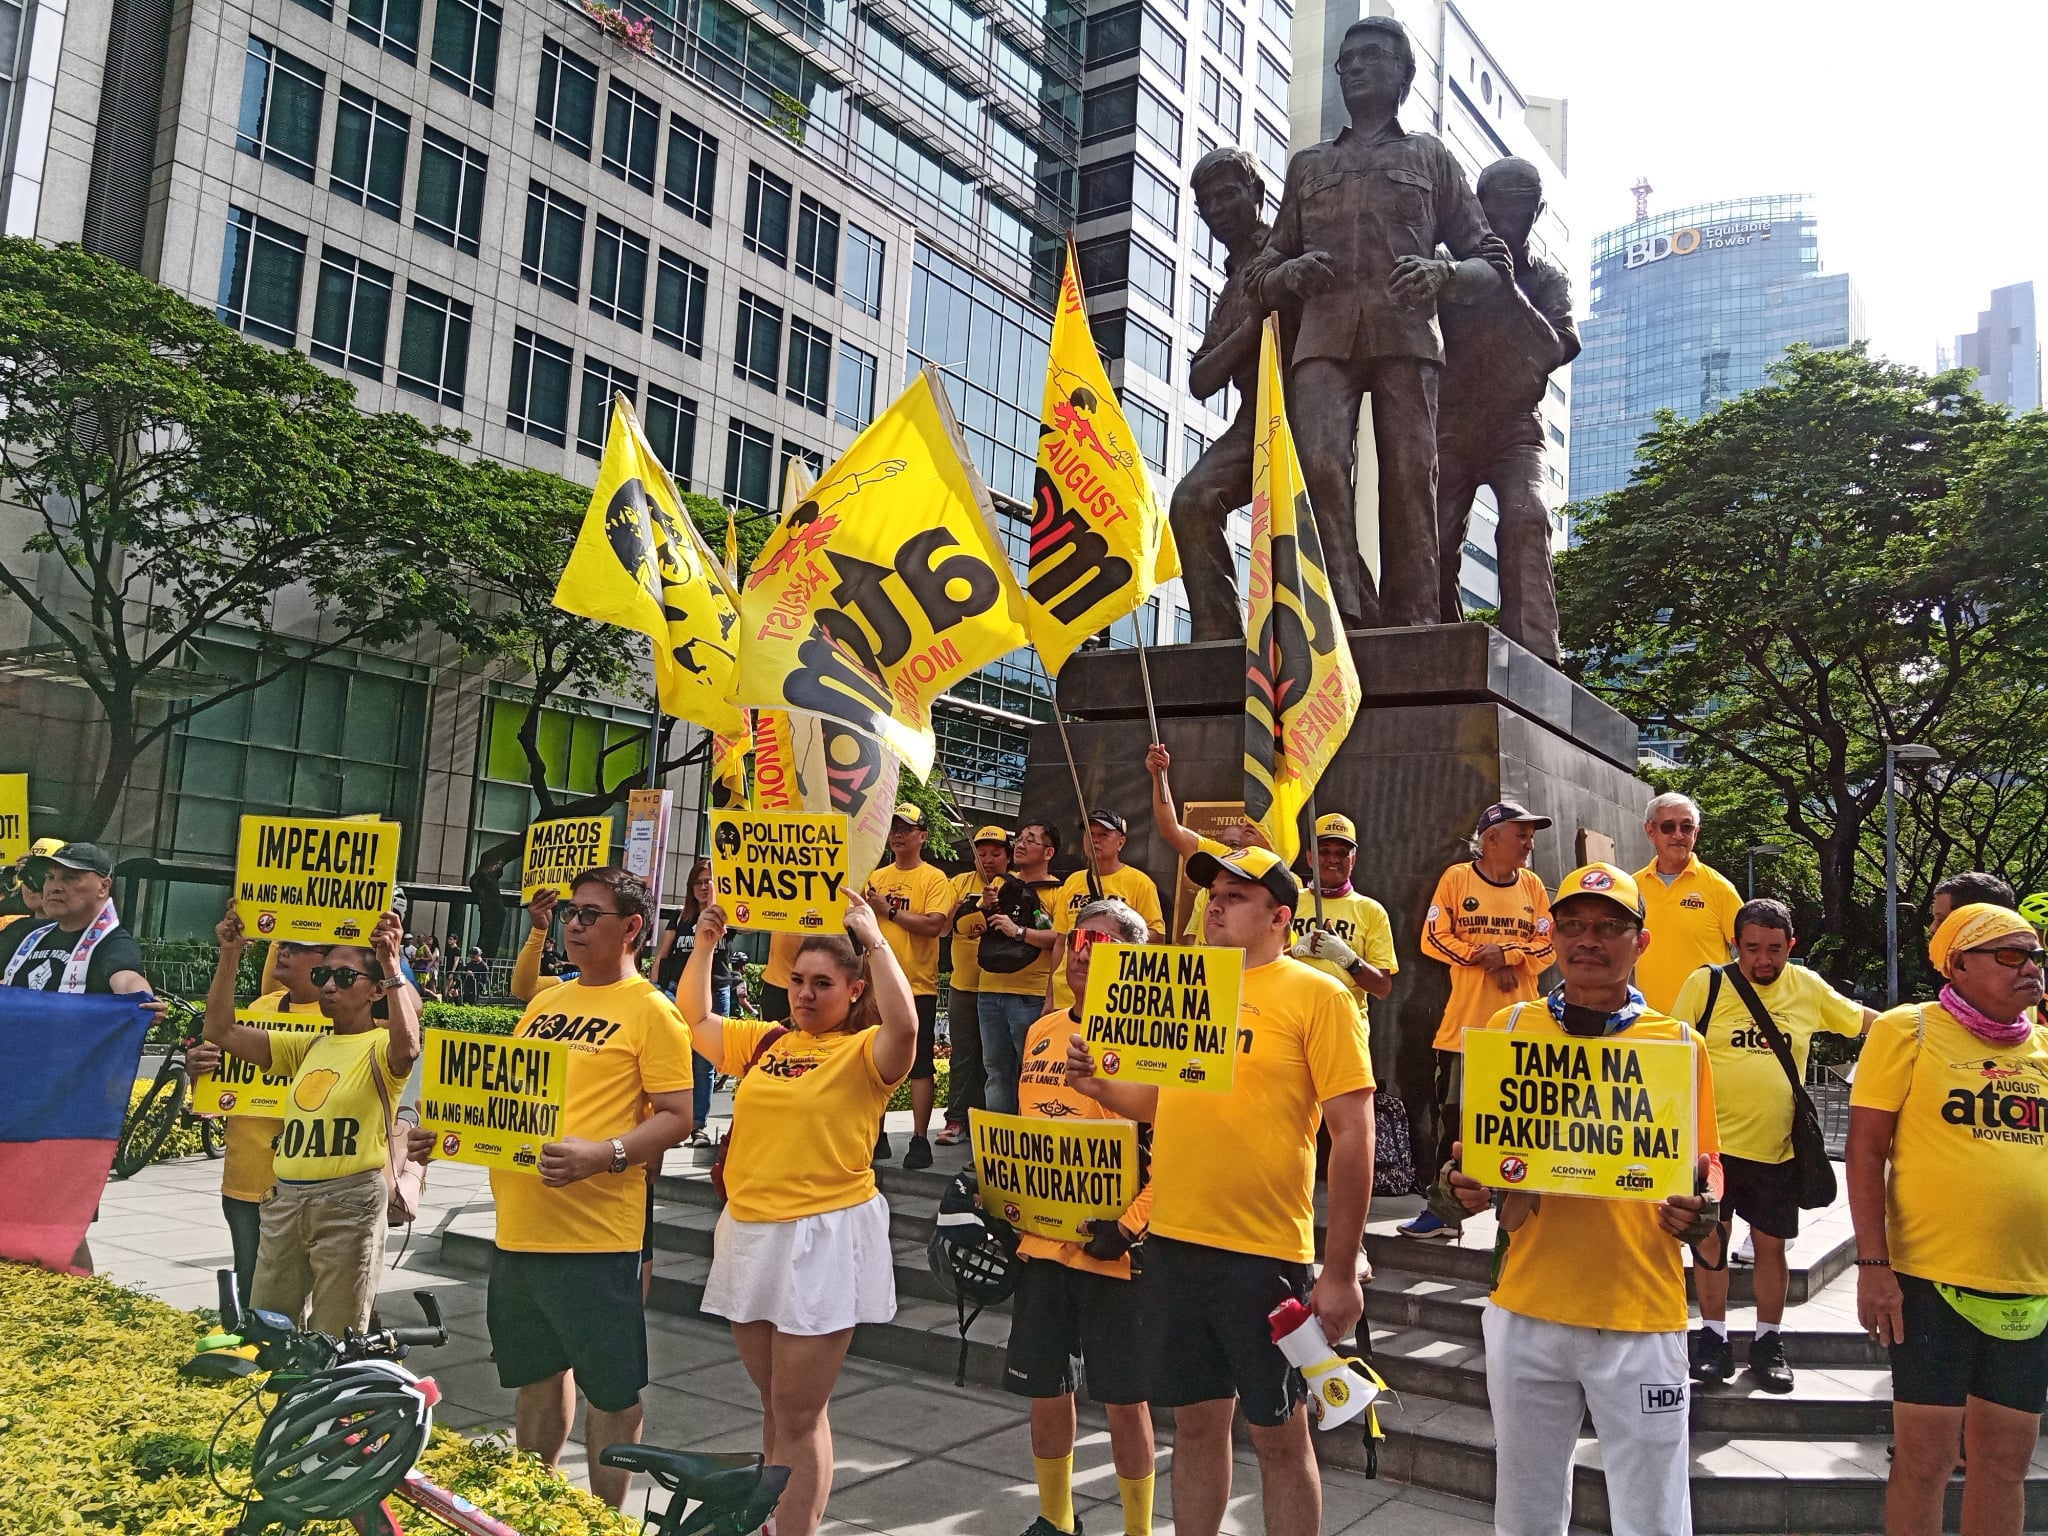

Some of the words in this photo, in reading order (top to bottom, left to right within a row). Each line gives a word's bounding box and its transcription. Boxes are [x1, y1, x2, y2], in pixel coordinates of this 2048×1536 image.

[1705, 221, 1771, 238] Equitable
[1706, 234, 1753, 249] Tower
[1624, 228, 1701, 270] BDO
[1044, 439, 1129, 529] AUGUST
[755, 717, 790, 810] NINOY!
[532, 821, 602, 848] MARCOS
[743, 822, 843, 845] POLITICAL
[257, 825, 379, 876] IMPEACH!
[529, 845, 600, 870] DUTERTE
[747, 844, 839, 866] DYNASTY
[537, 869, 546, 885] SA
[546, 868, 561, 884] ULO
[563, 867, 573, 883] NG
[718, 876, 732, 895] IS
[735, 866, 845, 902] NASTY
[241, 882, 254, 901] NA
[256, 884, 277, 903] ANG
[280, 886, 303, 905] MGA
[306, 876, 388, 912] KURAKOT
[1680, 897, 1705, 909] atom
[291, 920, 322, 928] ACRONYM
[798, 916, 823, 926] atom
[1458, 915, 1488, 927] YELLOW
[1491, 916, 1515, 928] ARMY
[1119, 951, 1170, 984] TAMA
[1177, 953, 1207, 986] NA
[1105, 983, 1175, 1018] SOBRA
[1182, 988, 1211, 1021] NA
[523, 1013, 621, 1047] ROAR!
[1086, 1015, 1188, 1051] IPAKULONG
[1194, 1022, 1227, 1055] NA!
[440, 1039, 550, 1097] IMPEACH!
[1136, 1060, 1167, 1069] ACRONYM
[1179, 1067, 1205, 1081] atom
[1511, 1040, 1591, 1081] TAMA
[1601, 1047, 1643, 1084] NA
[1499, 1077, 1602, 1119] SOBRA
[1612, 1086, 1654, 1123] NA
[1996, 1081, 2040, 1095] AUGUST
[426, 1100, 439, 1120] NA
[441, 1103, 461, 1124] ANG
[464, 1105, 484, 1127] MGA
[487, 1096, 559, 1137] KURAKOT
[474, 1143, 502, 1153] ACRONYM
[979, 1125, 985, 1153] I
[989, 1126, 1054, 1164] KULONG
[1059, 1136, 1083, 1167] NA
[1086, 1138, 1122, 1169] YAN
[1475, 1113, 1623, 1156] IPAKULONG
[1633, 1126, 1679, 1160] NA!
[1972, 1127, 2045, 1146] MOVEMENT
[512, 1151, 536, 1165] atom
[982, 1156, 1021, 1194] MGA
[1025, 1165, 1122, 1206] KURAKOT!
[1551, 1166, 1596, 1177] ACRONYM
[1615, 1171, 1653, 1189] atom
[1033, 1215, 1063, 1226] ACRONYM
